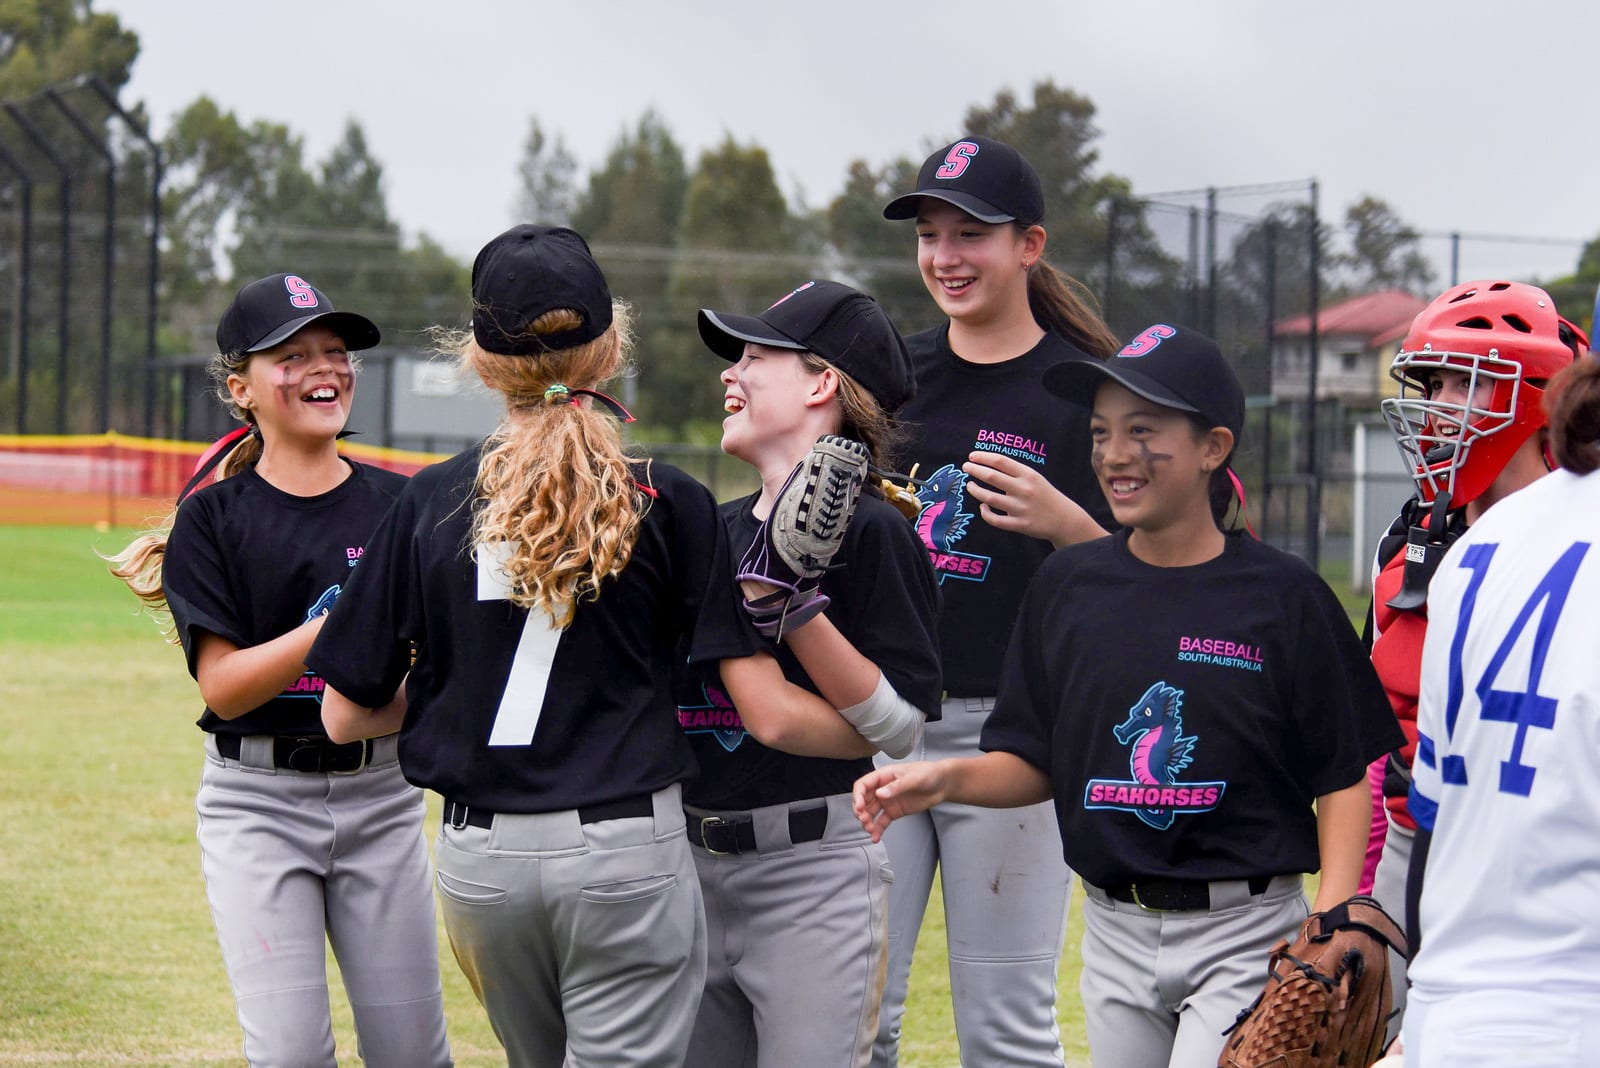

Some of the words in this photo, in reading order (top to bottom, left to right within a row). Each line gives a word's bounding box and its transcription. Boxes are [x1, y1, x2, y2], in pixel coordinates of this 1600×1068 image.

[935, 141, 980, 179] S
[284, 275, 319, 308] S
[1117, 324, 1176, 358] S
[974, 441, 1002, 453] SOUTH
[1001, 446, 1045, 465] AUSTRALIA
[977, 429, 1047, 457] BASEBALL
[1177, 651, 1212, 664] SOUTH
[1211, 655, 1262, 673] AUSTRALIA
[1179, 636, 1264, 663] BASEBALL
[1441, 541, 1592, 798] 14
[1090, 784, 1219, 807] SEAHORSES
